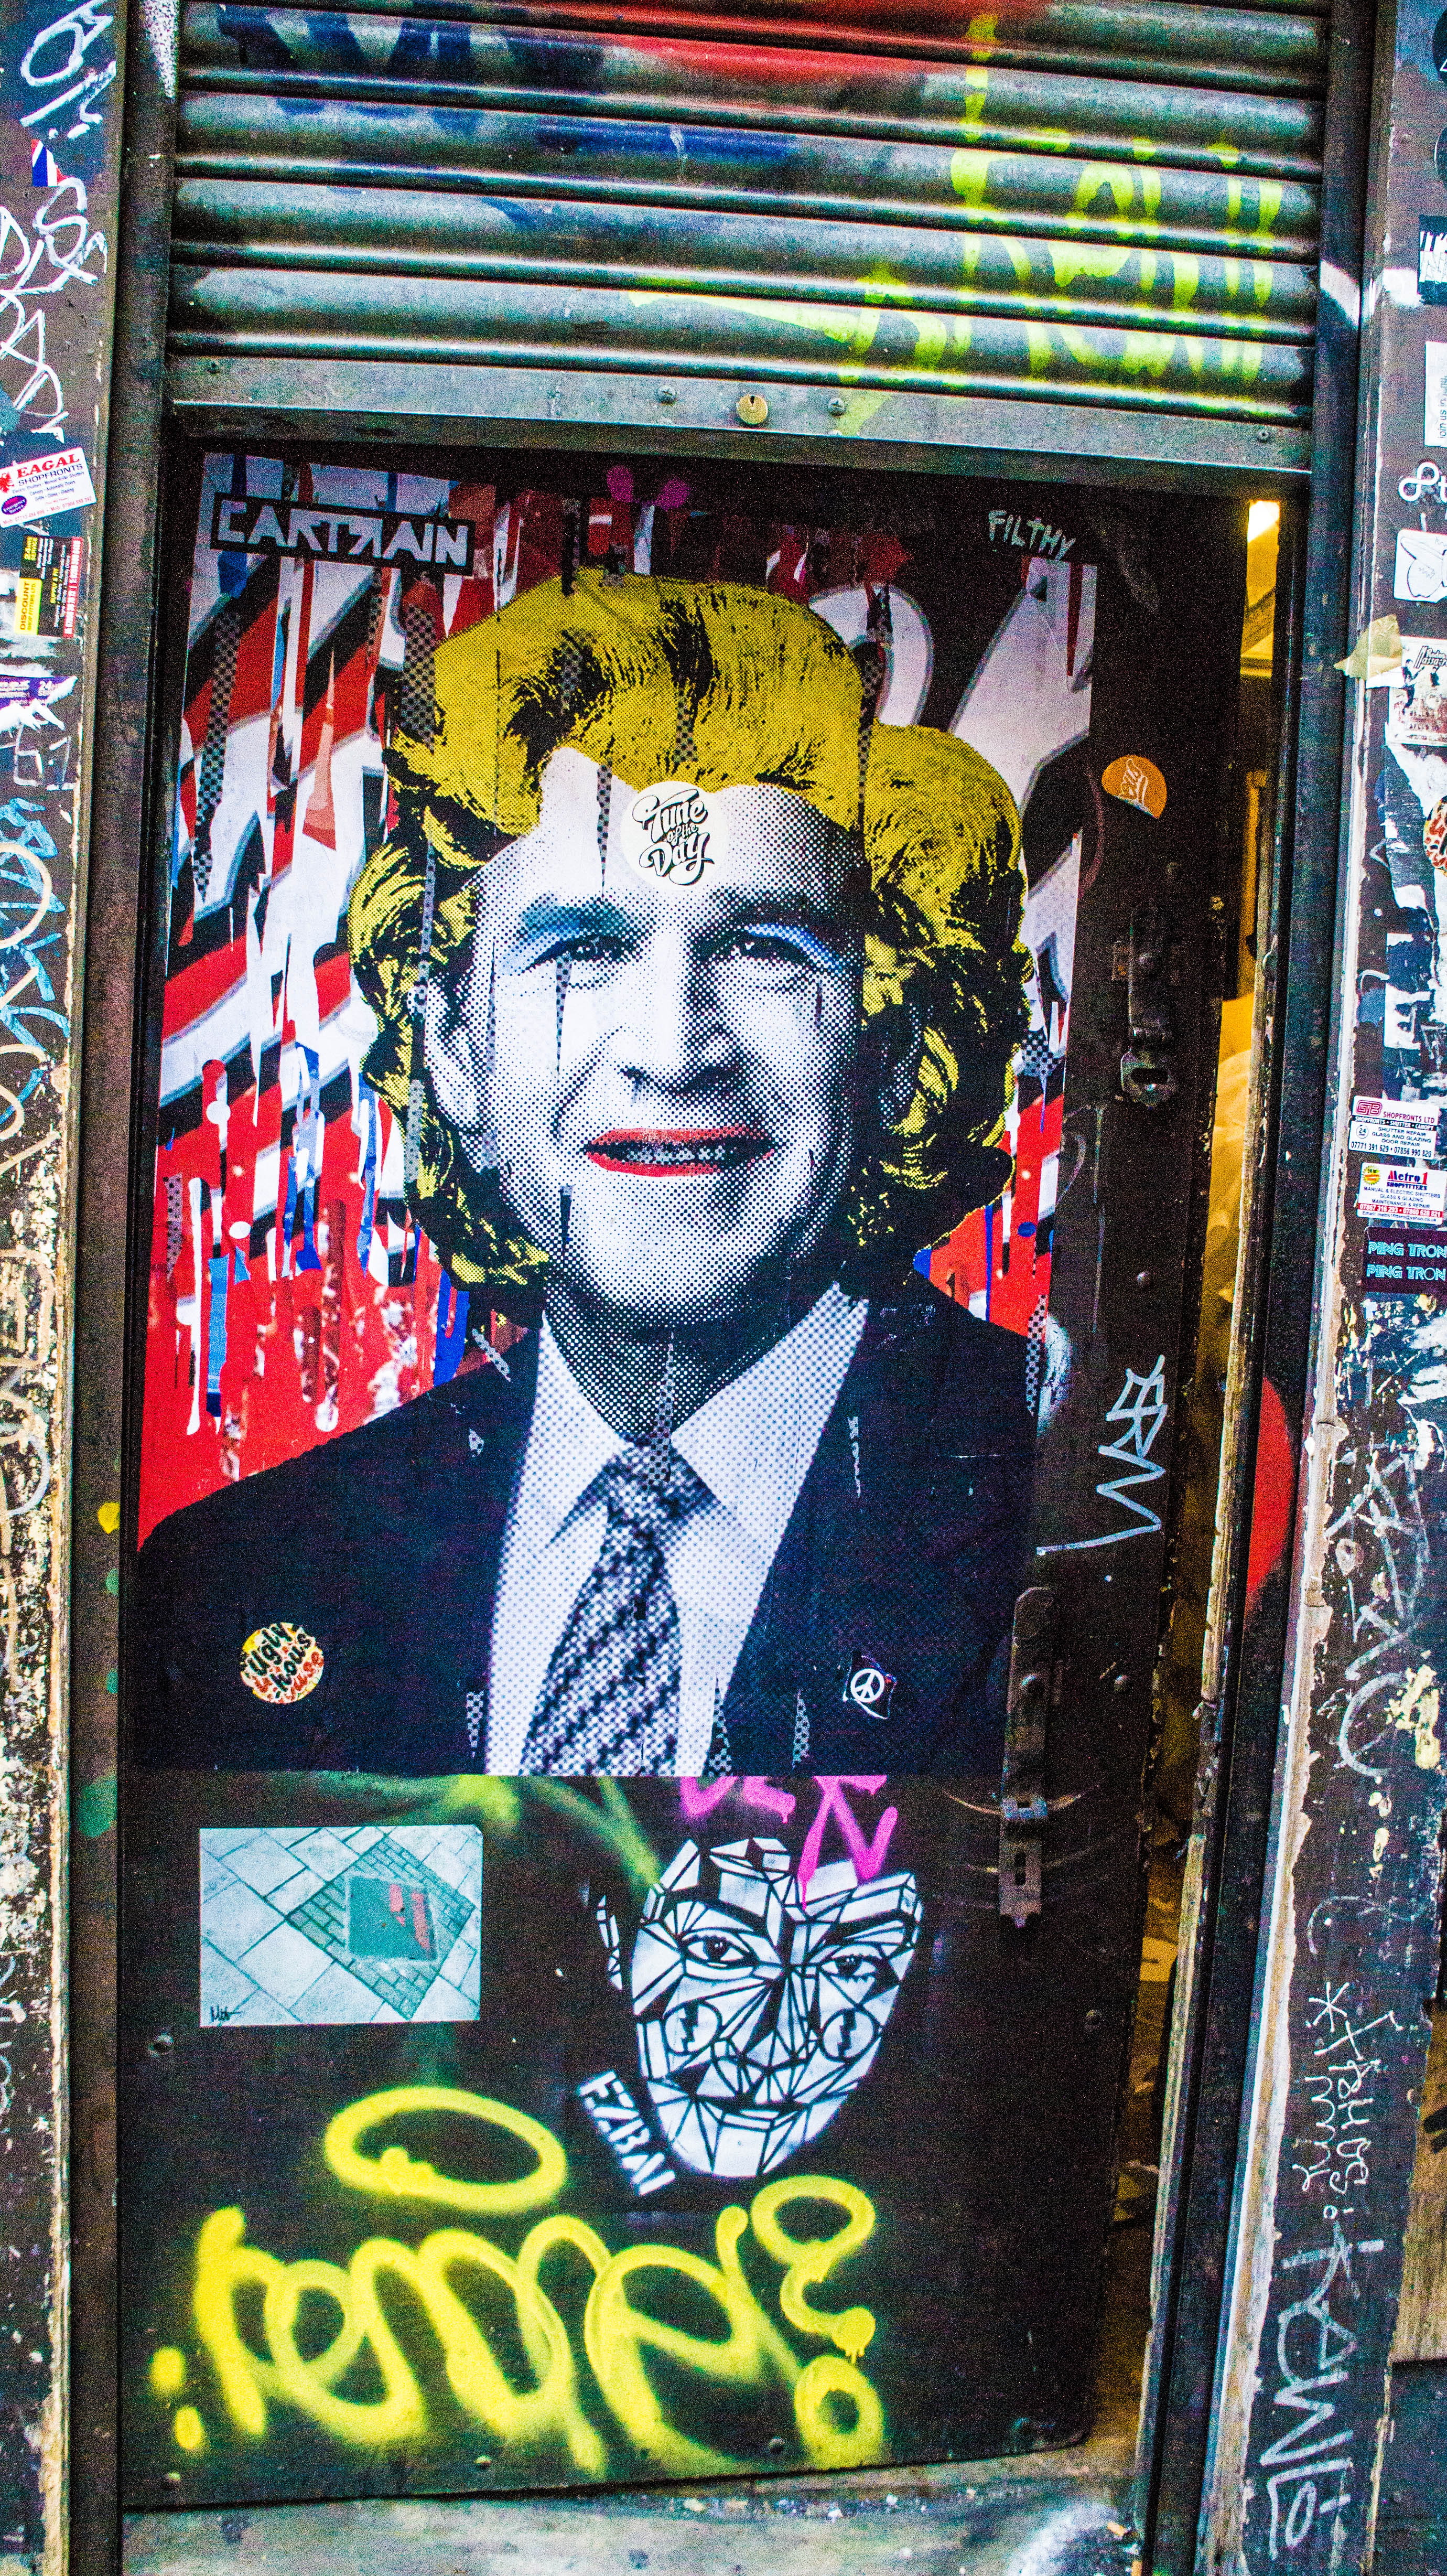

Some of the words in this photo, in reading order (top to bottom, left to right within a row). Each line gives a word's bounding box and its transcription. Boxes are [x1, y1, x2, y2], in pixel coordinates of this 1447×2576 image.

[17, 454, 80, 478] EAGAL
[18, 464, 83, 486] SHOPFRONTS
[988, 510, 1076, 561] FILTHY
[49, 583, 58, 604] SUPPLY
[19, 582, 30, 630] DISCOUNT
[632, 789, 708, 843] Tune
[639, 832, 715, 885] Day
[1355, 1115, 1385, 1124] SHOPFRONTS
[1389, 1120, 1411, 1128] SHUTTER
[1383, 1111, 1422, 1122] SHOPFRONTS
[1351, 1141, 1366, 1150] 07771
[1386, 1181, 1427, 1191] SHOPFITTERS
[1367, 1241, 1404, 1256] PING
[1408, 1243, 1447, 1259] TRON
[1366, 1264, 1403, 1280] PING
[1406, 1266, 1446, 1281] TRON
